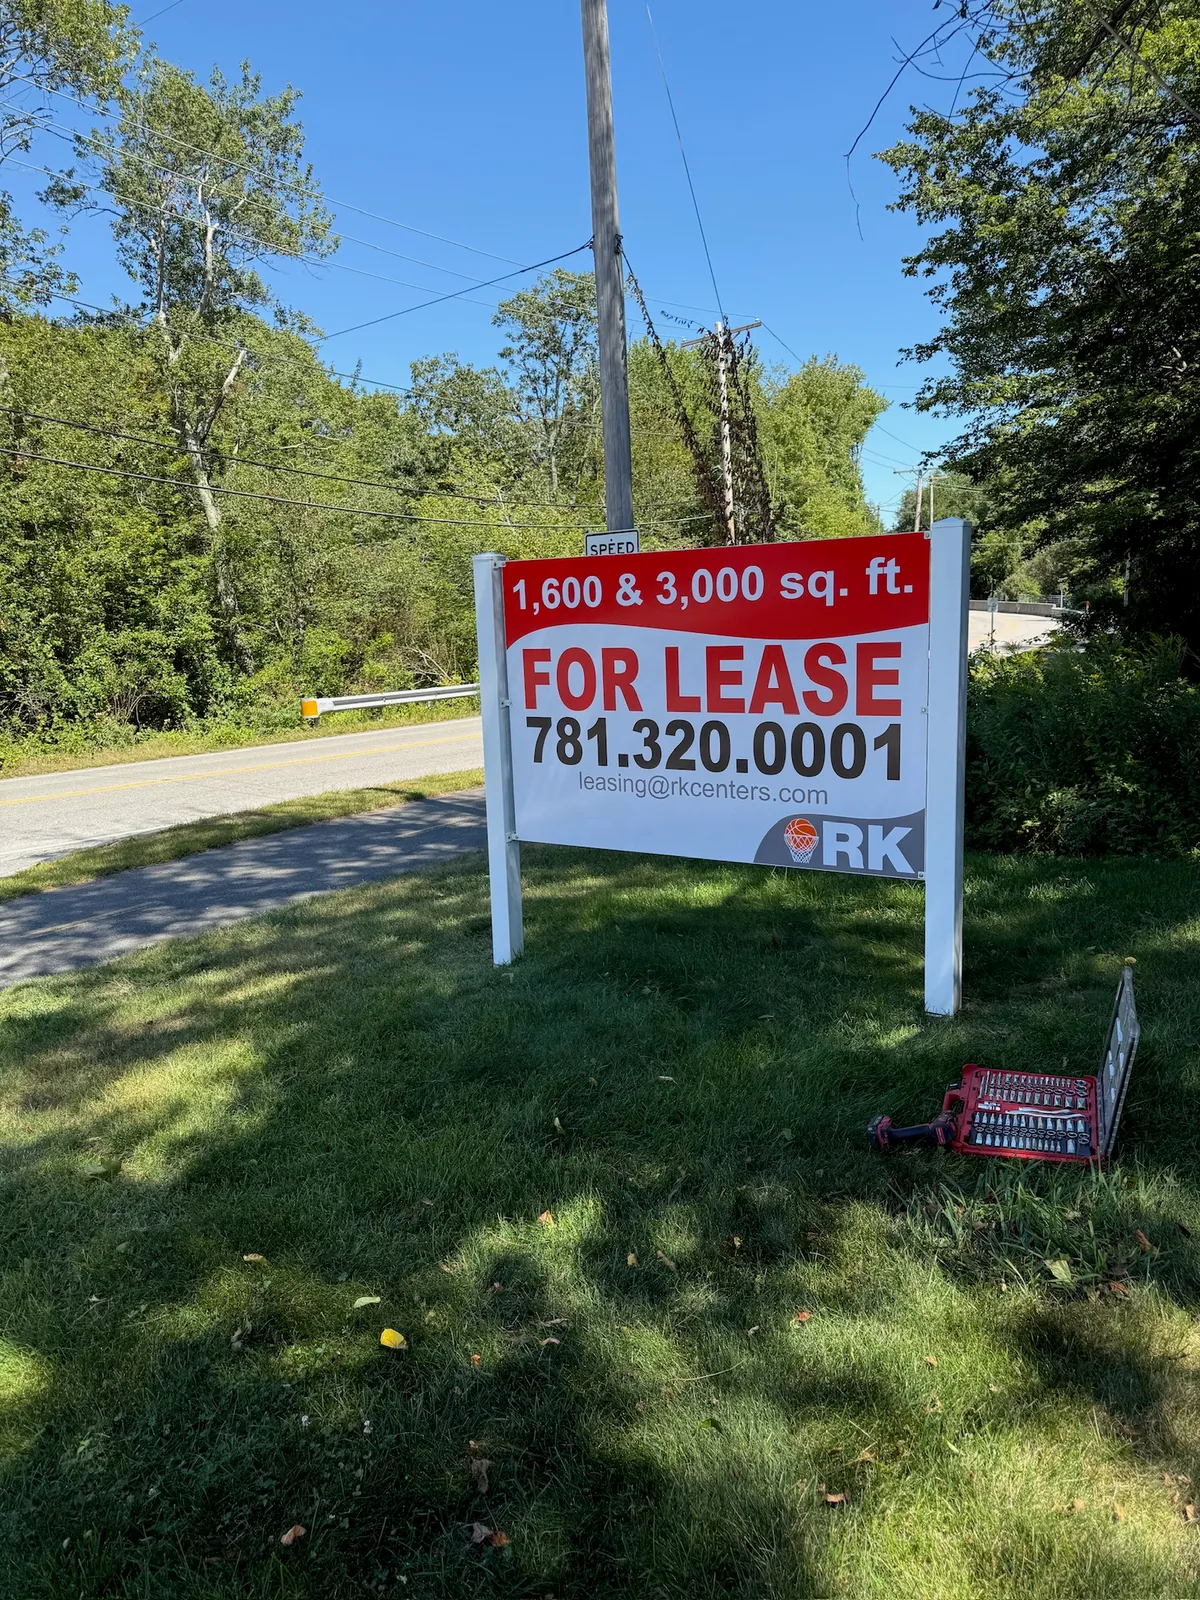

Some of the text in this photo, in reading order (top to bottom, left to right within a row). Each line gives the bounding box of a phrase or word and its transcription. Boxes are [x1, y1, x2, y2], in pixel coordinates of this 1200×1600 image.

[590, 541, 635, 555] SPEED
[512, 556, 914, 615] 1,600 & 3,000 sq. ft.
[522, 641, 902, 717] FOR LEASE
[526, 716, 901, 781] 781.320.0001
[578, 771, 829, 806] leasing@rkcenters.com
[822, 820, 916, 874] RK
